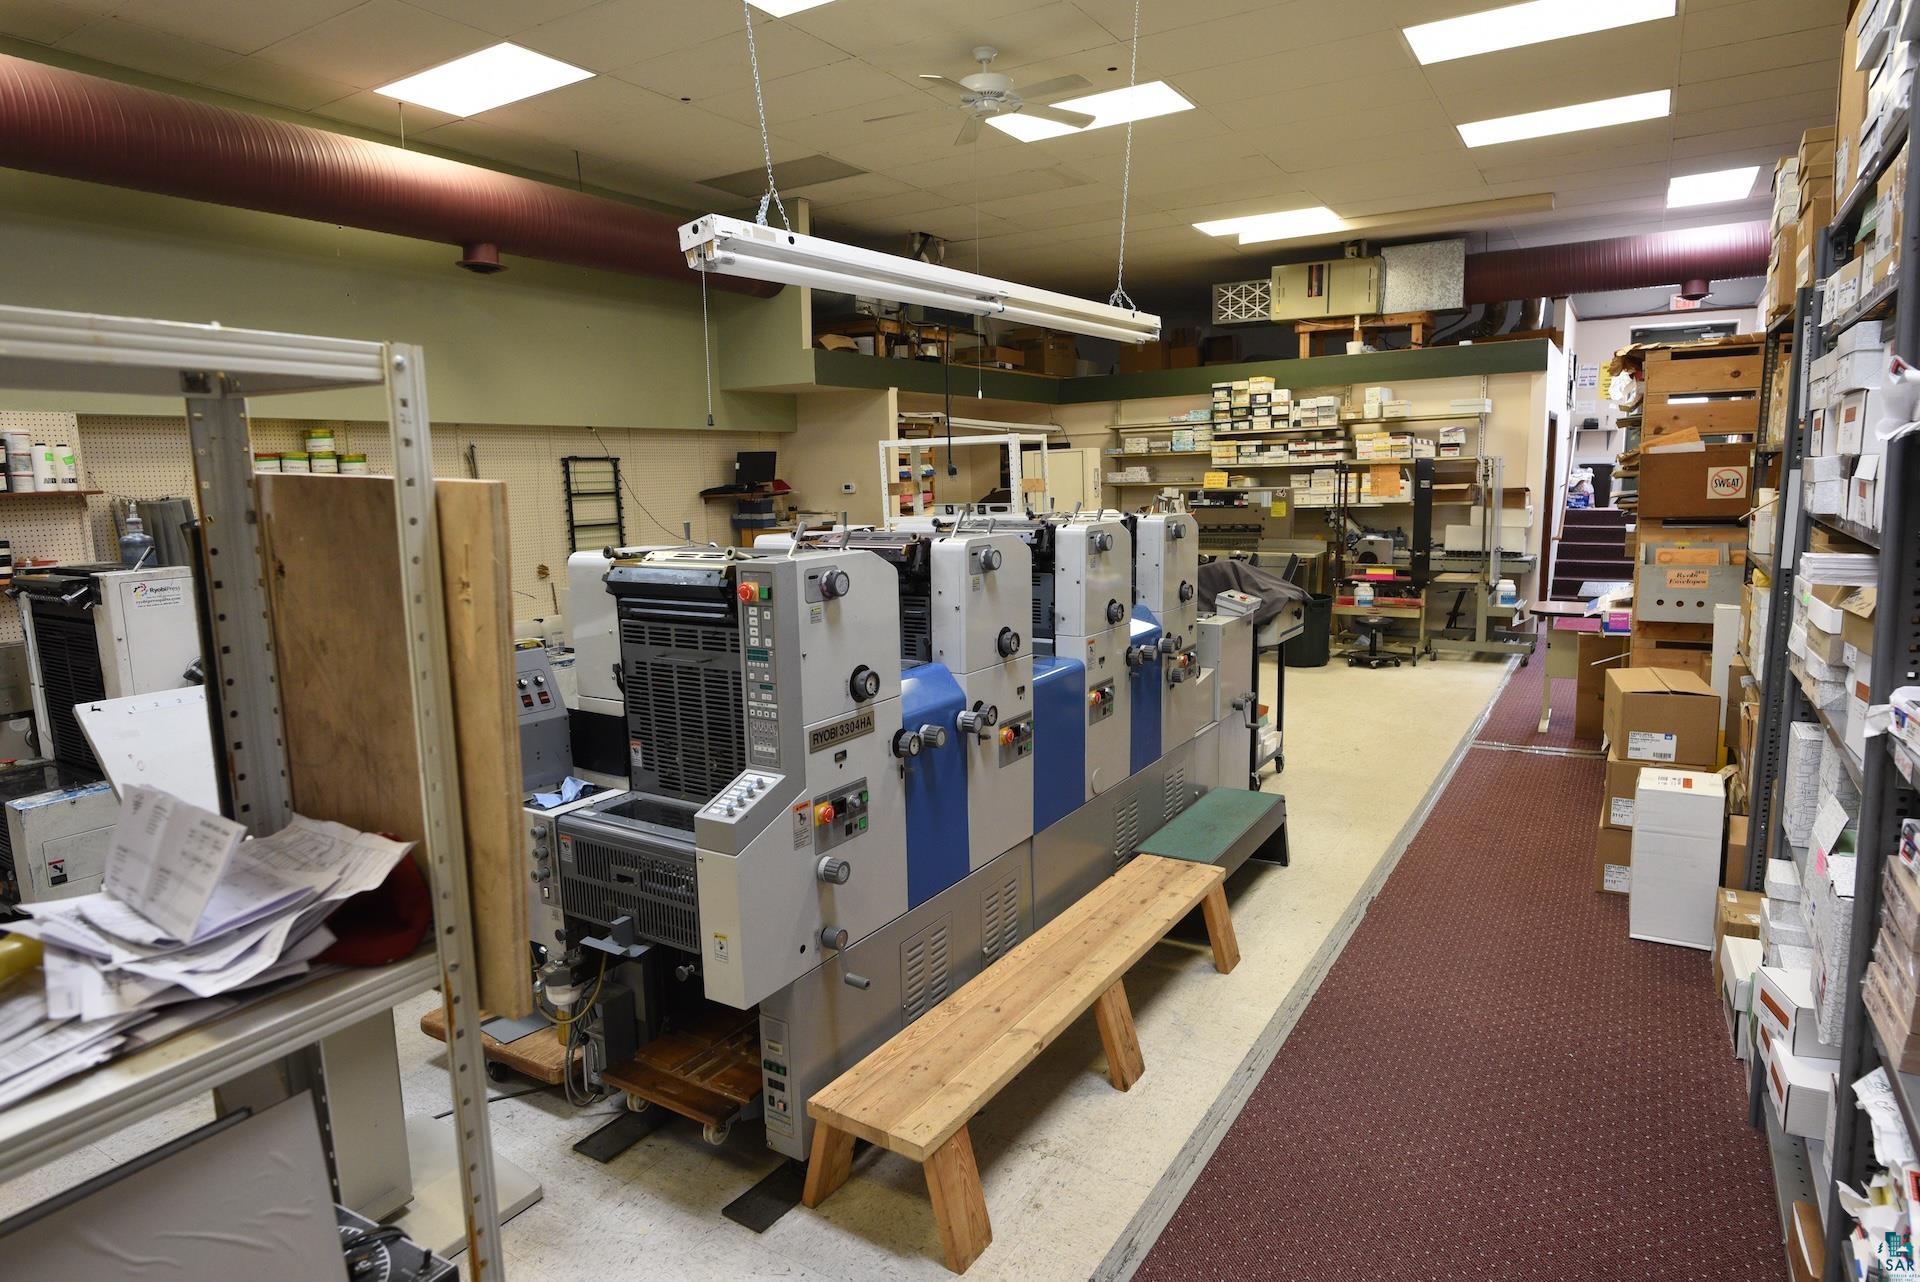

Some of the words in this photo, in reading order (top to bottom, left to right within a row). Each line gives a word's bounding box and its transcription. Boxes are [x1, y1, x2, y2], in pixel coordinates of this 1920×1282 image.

[1714, 478, 1740, 488] SWEAT
[812, 726, 838, 746] RYOBI
[840, 716, 872, 736] 3304HA
